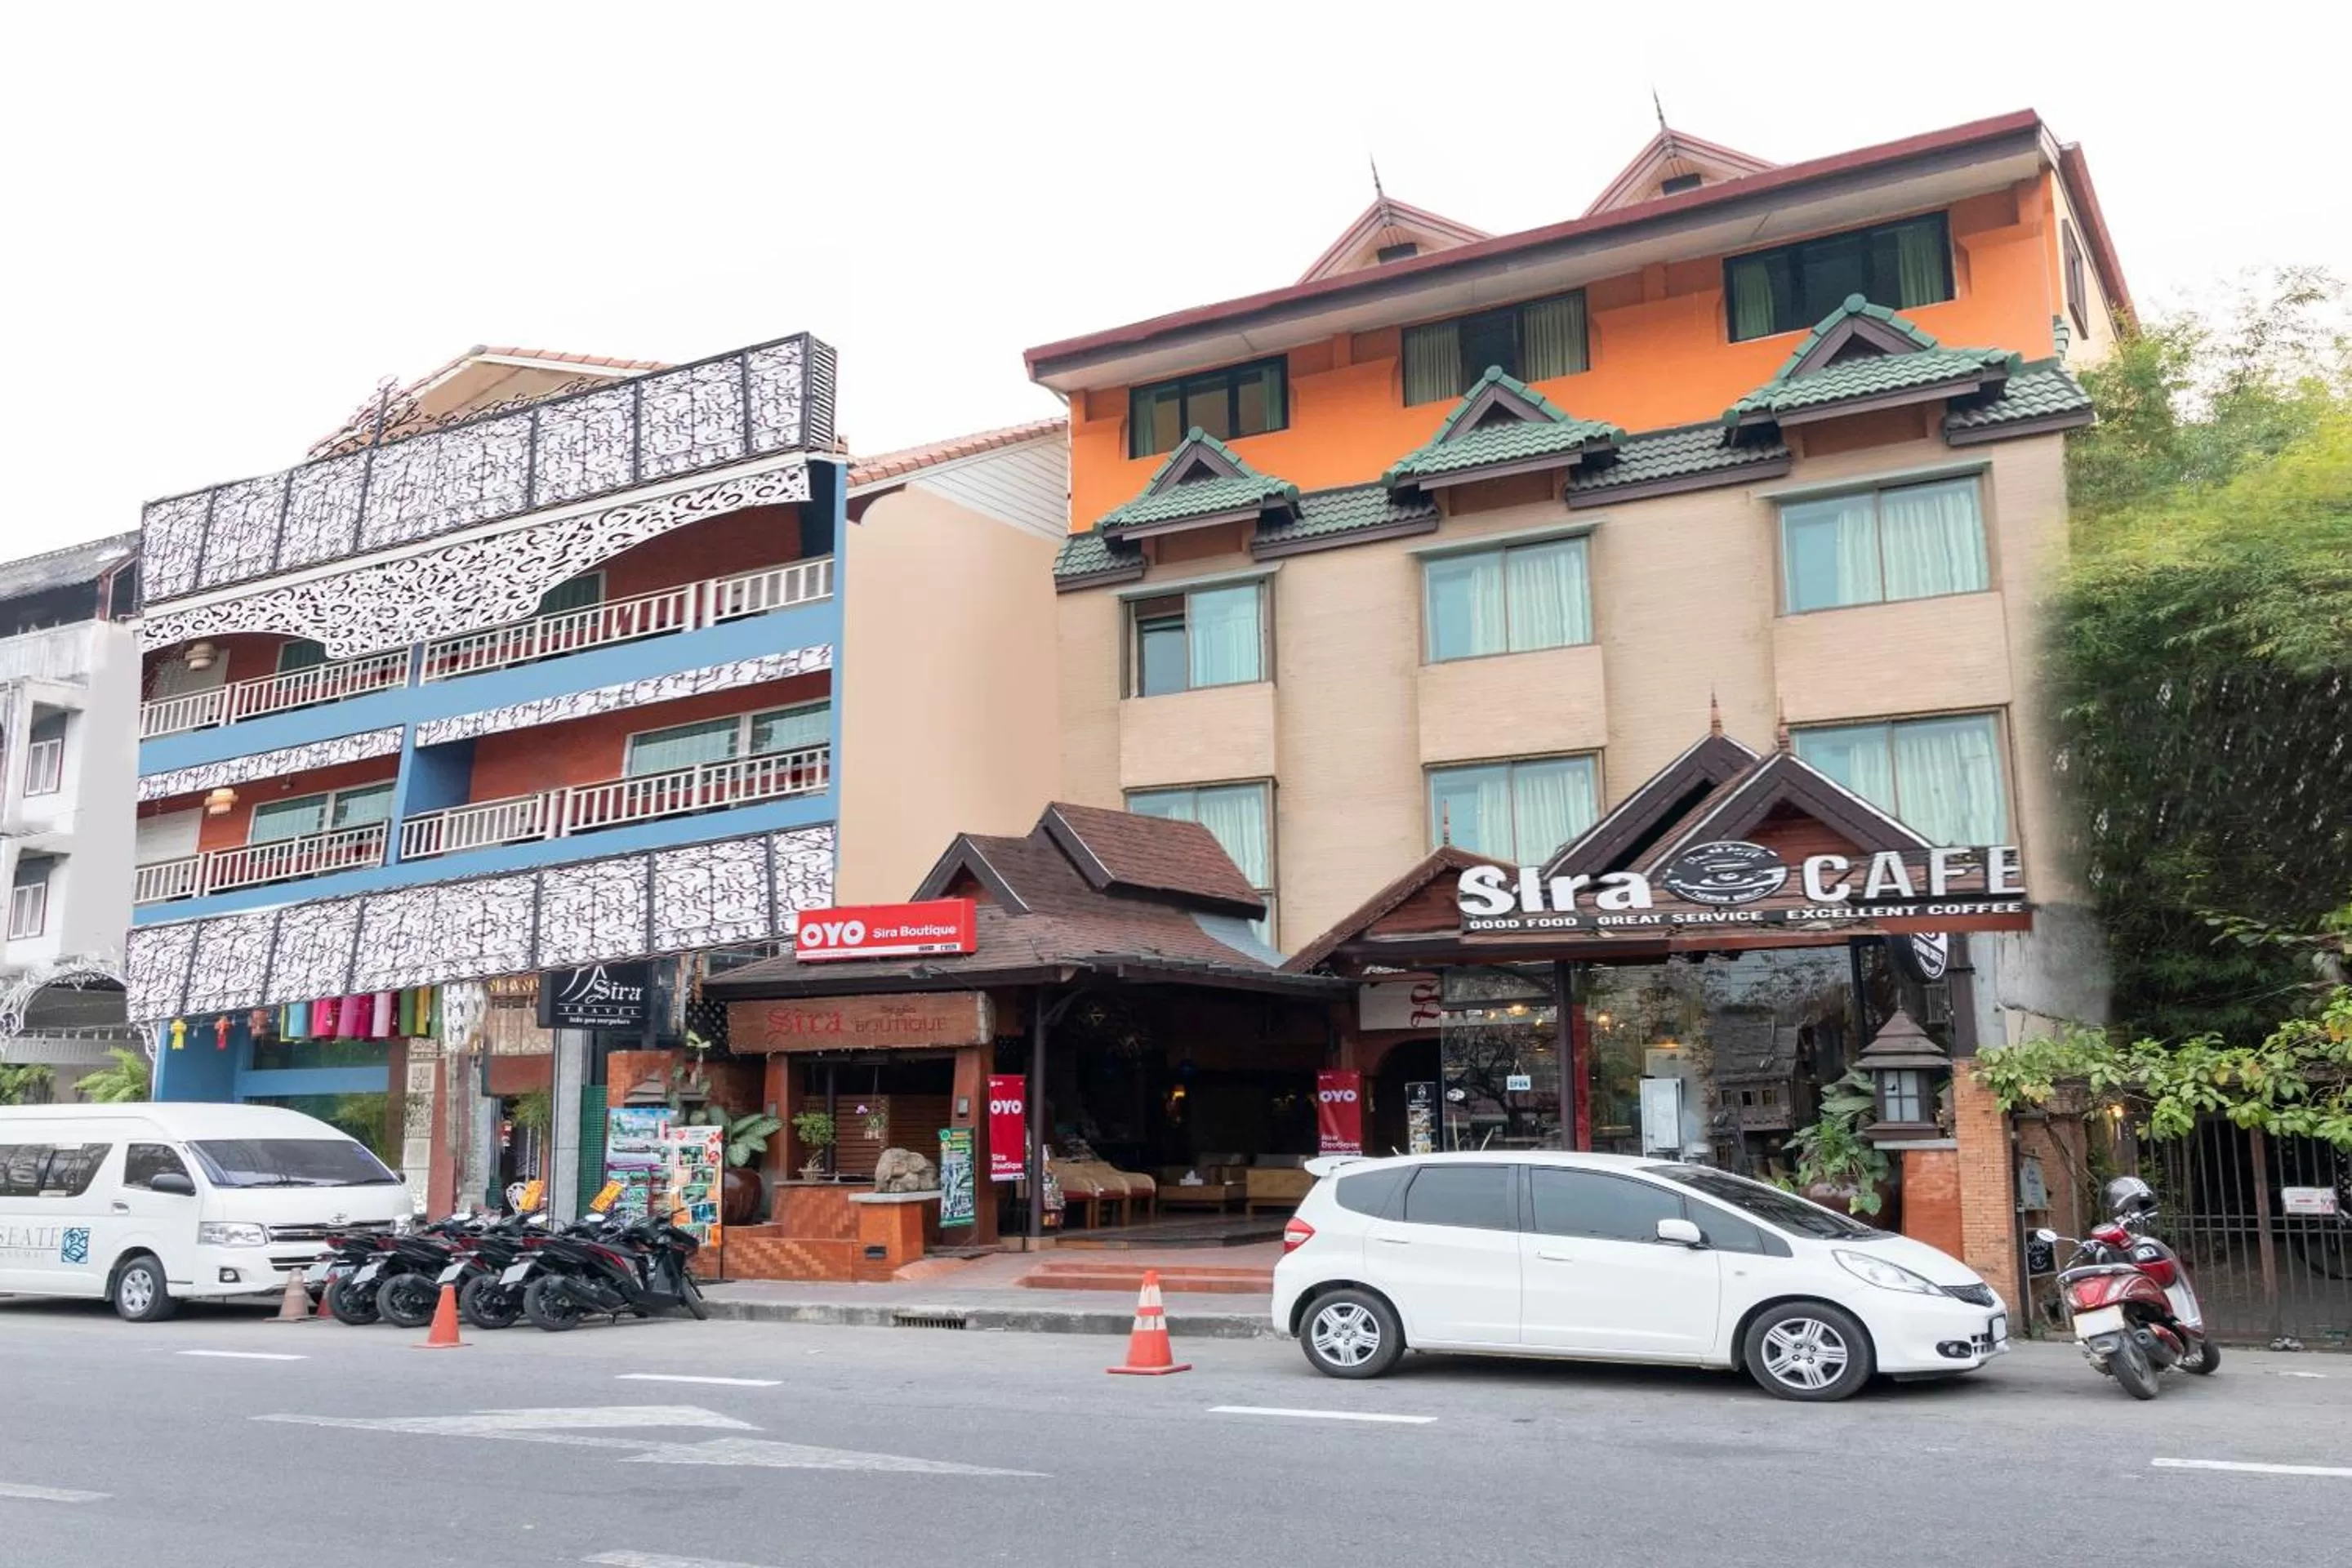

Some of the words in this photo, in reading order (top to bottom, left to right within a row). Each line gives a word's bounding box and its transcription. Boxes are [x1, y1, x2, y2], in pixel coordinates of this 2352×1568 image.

[1803, 846, 2026, 902] CAFE
[1470, 918, 1520, 929] GOOD
[1527, 916, 1578, 928] FOOD
[1597, 914, 1661, 925] GREAT
[1672, 909, 1764, 924] SERVICE
[1787, 905, 1919, 920] EXCELLENT
[1927, 902, 2023, 915] COFFEE
[800, 920, 866, 947] OYO
[872, 928, 898, 938] Sira
[900, 924, 958, 938] Boutique
[586, 978, 643, 1004] Sira
[991, 1100, 1022, 1115] OYO
[1319, 1089, 1357, 1103] OYO
